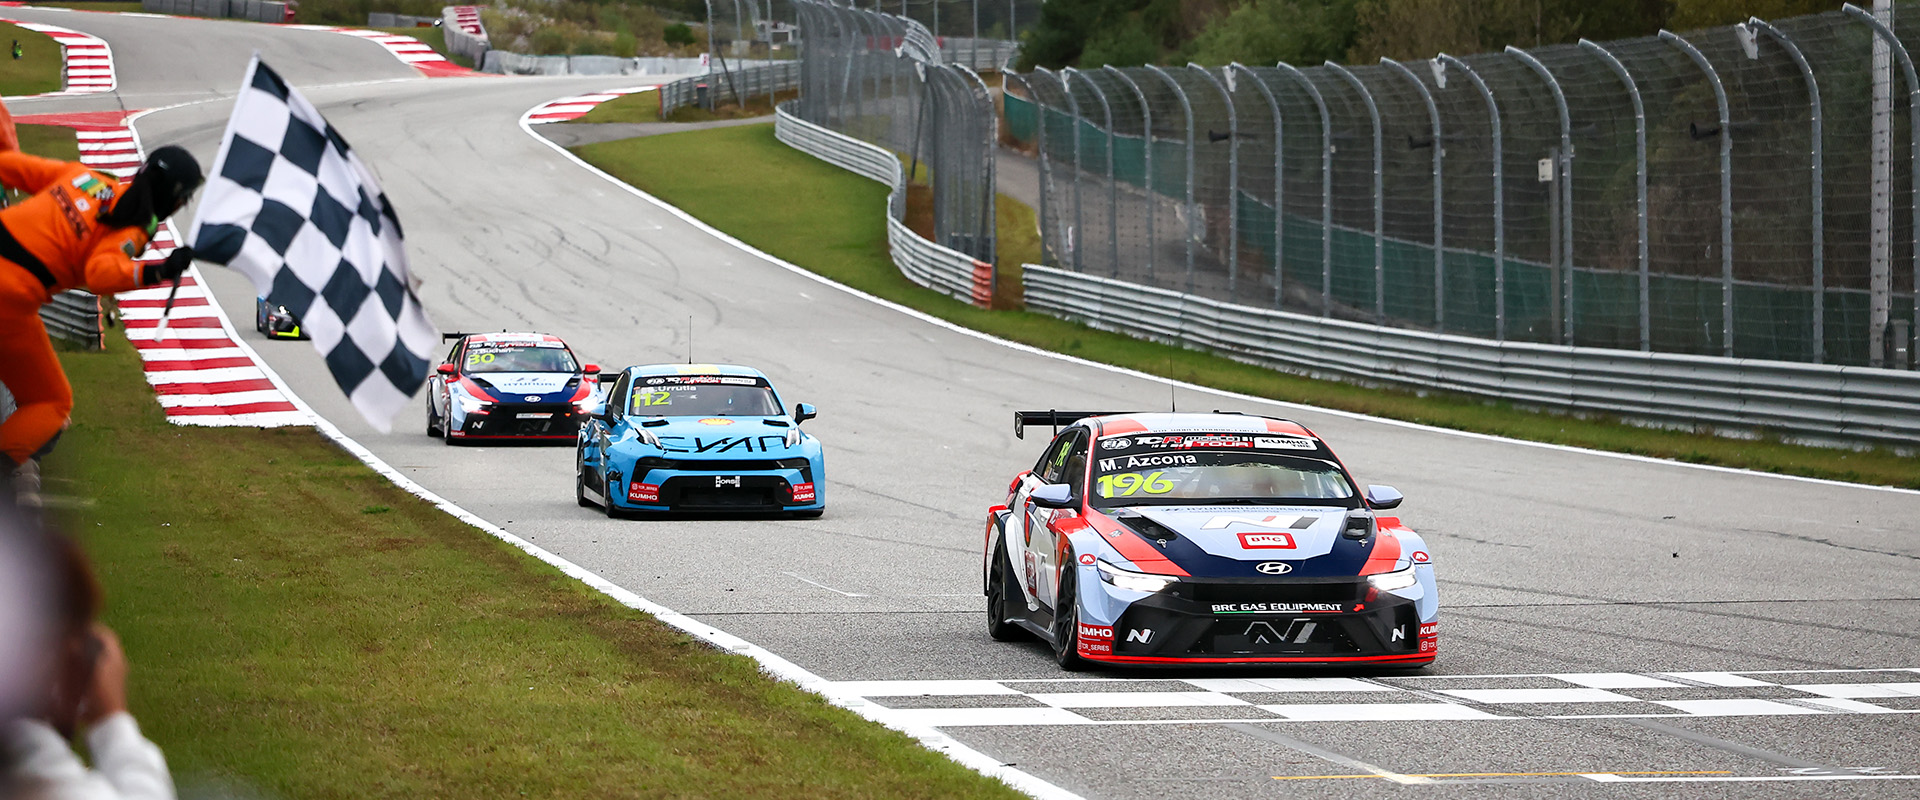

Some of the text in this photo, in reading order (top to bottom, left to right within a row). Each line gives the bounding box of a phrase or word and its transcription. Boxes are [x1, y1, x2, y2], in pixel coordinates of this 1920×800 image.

[468, 353, 496, 365] 30
[631, 391, 671, 408] 112
[1102, 439, 1131, 449] FIA
[1135, 436, 1182, 445] TCR
[1099, 454, 1197, 472] M. Azcona
[1097, 472, 1174, 499] 196
[630, 492, 657, 500] KUMHO
[1211, 603, 1342, 612] BRC GAS EQUIPMENT
[1126, 628, 1155, 644] N
[1391, 623, 1405, 642] N
